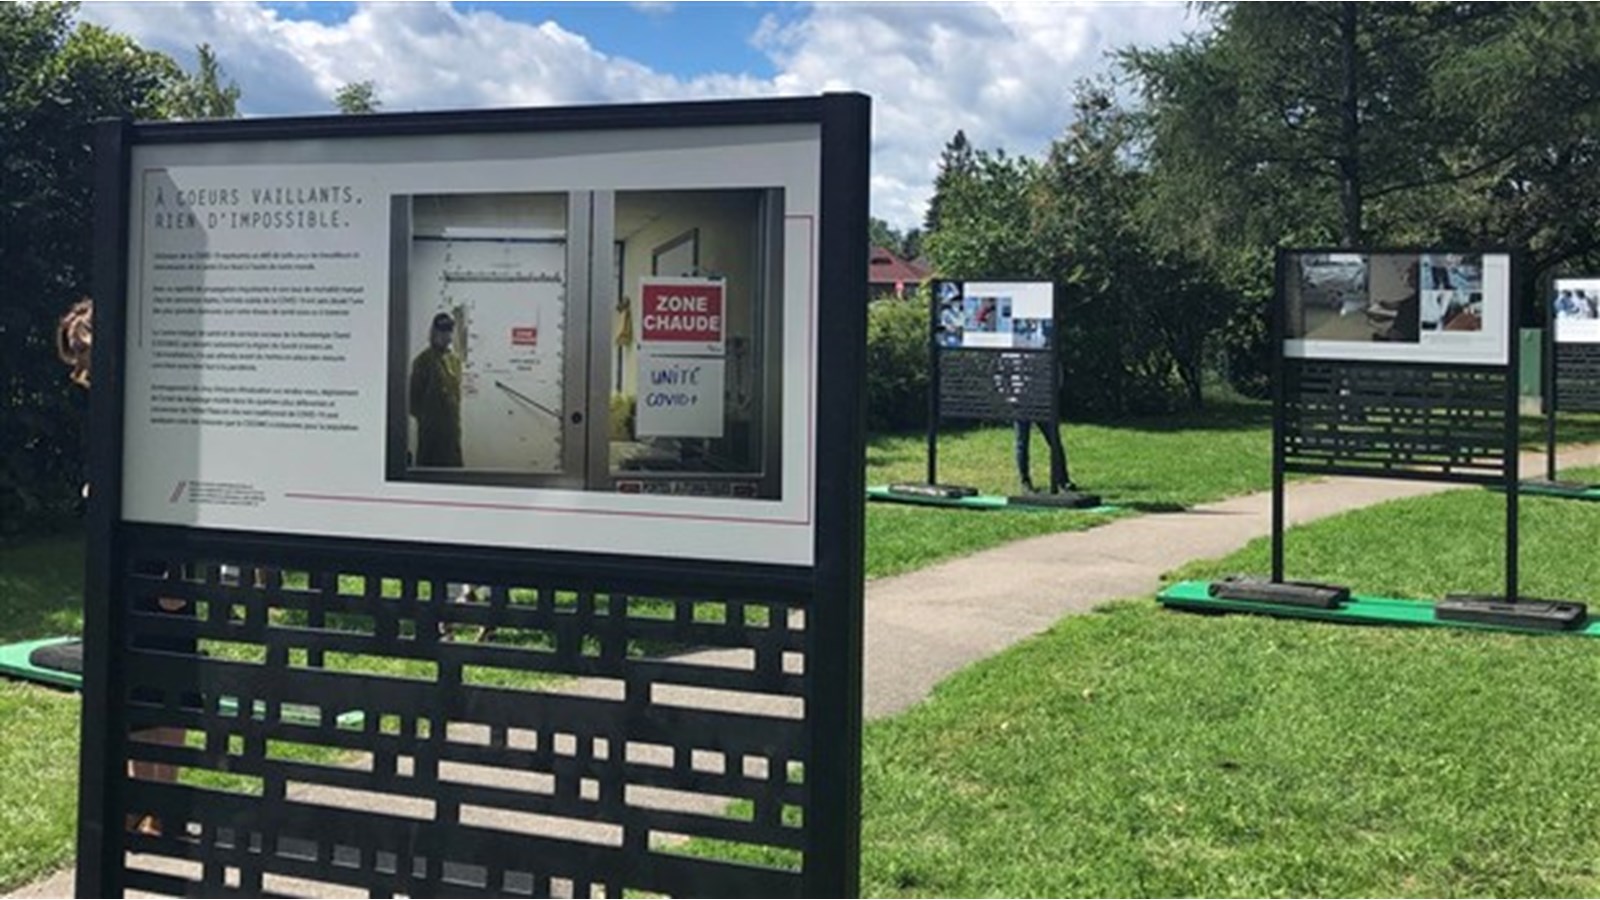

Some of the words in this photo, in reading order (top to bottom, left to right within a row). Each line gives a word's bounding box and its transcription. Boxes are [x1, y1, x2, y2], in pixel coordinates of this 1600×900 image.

[176, 188, 240, 207] COEURS
[154, 211, 195, 229] RIEN
[656, 295, 708, 312] ZONE
[644, 315, 720, 331] CHAUDE
